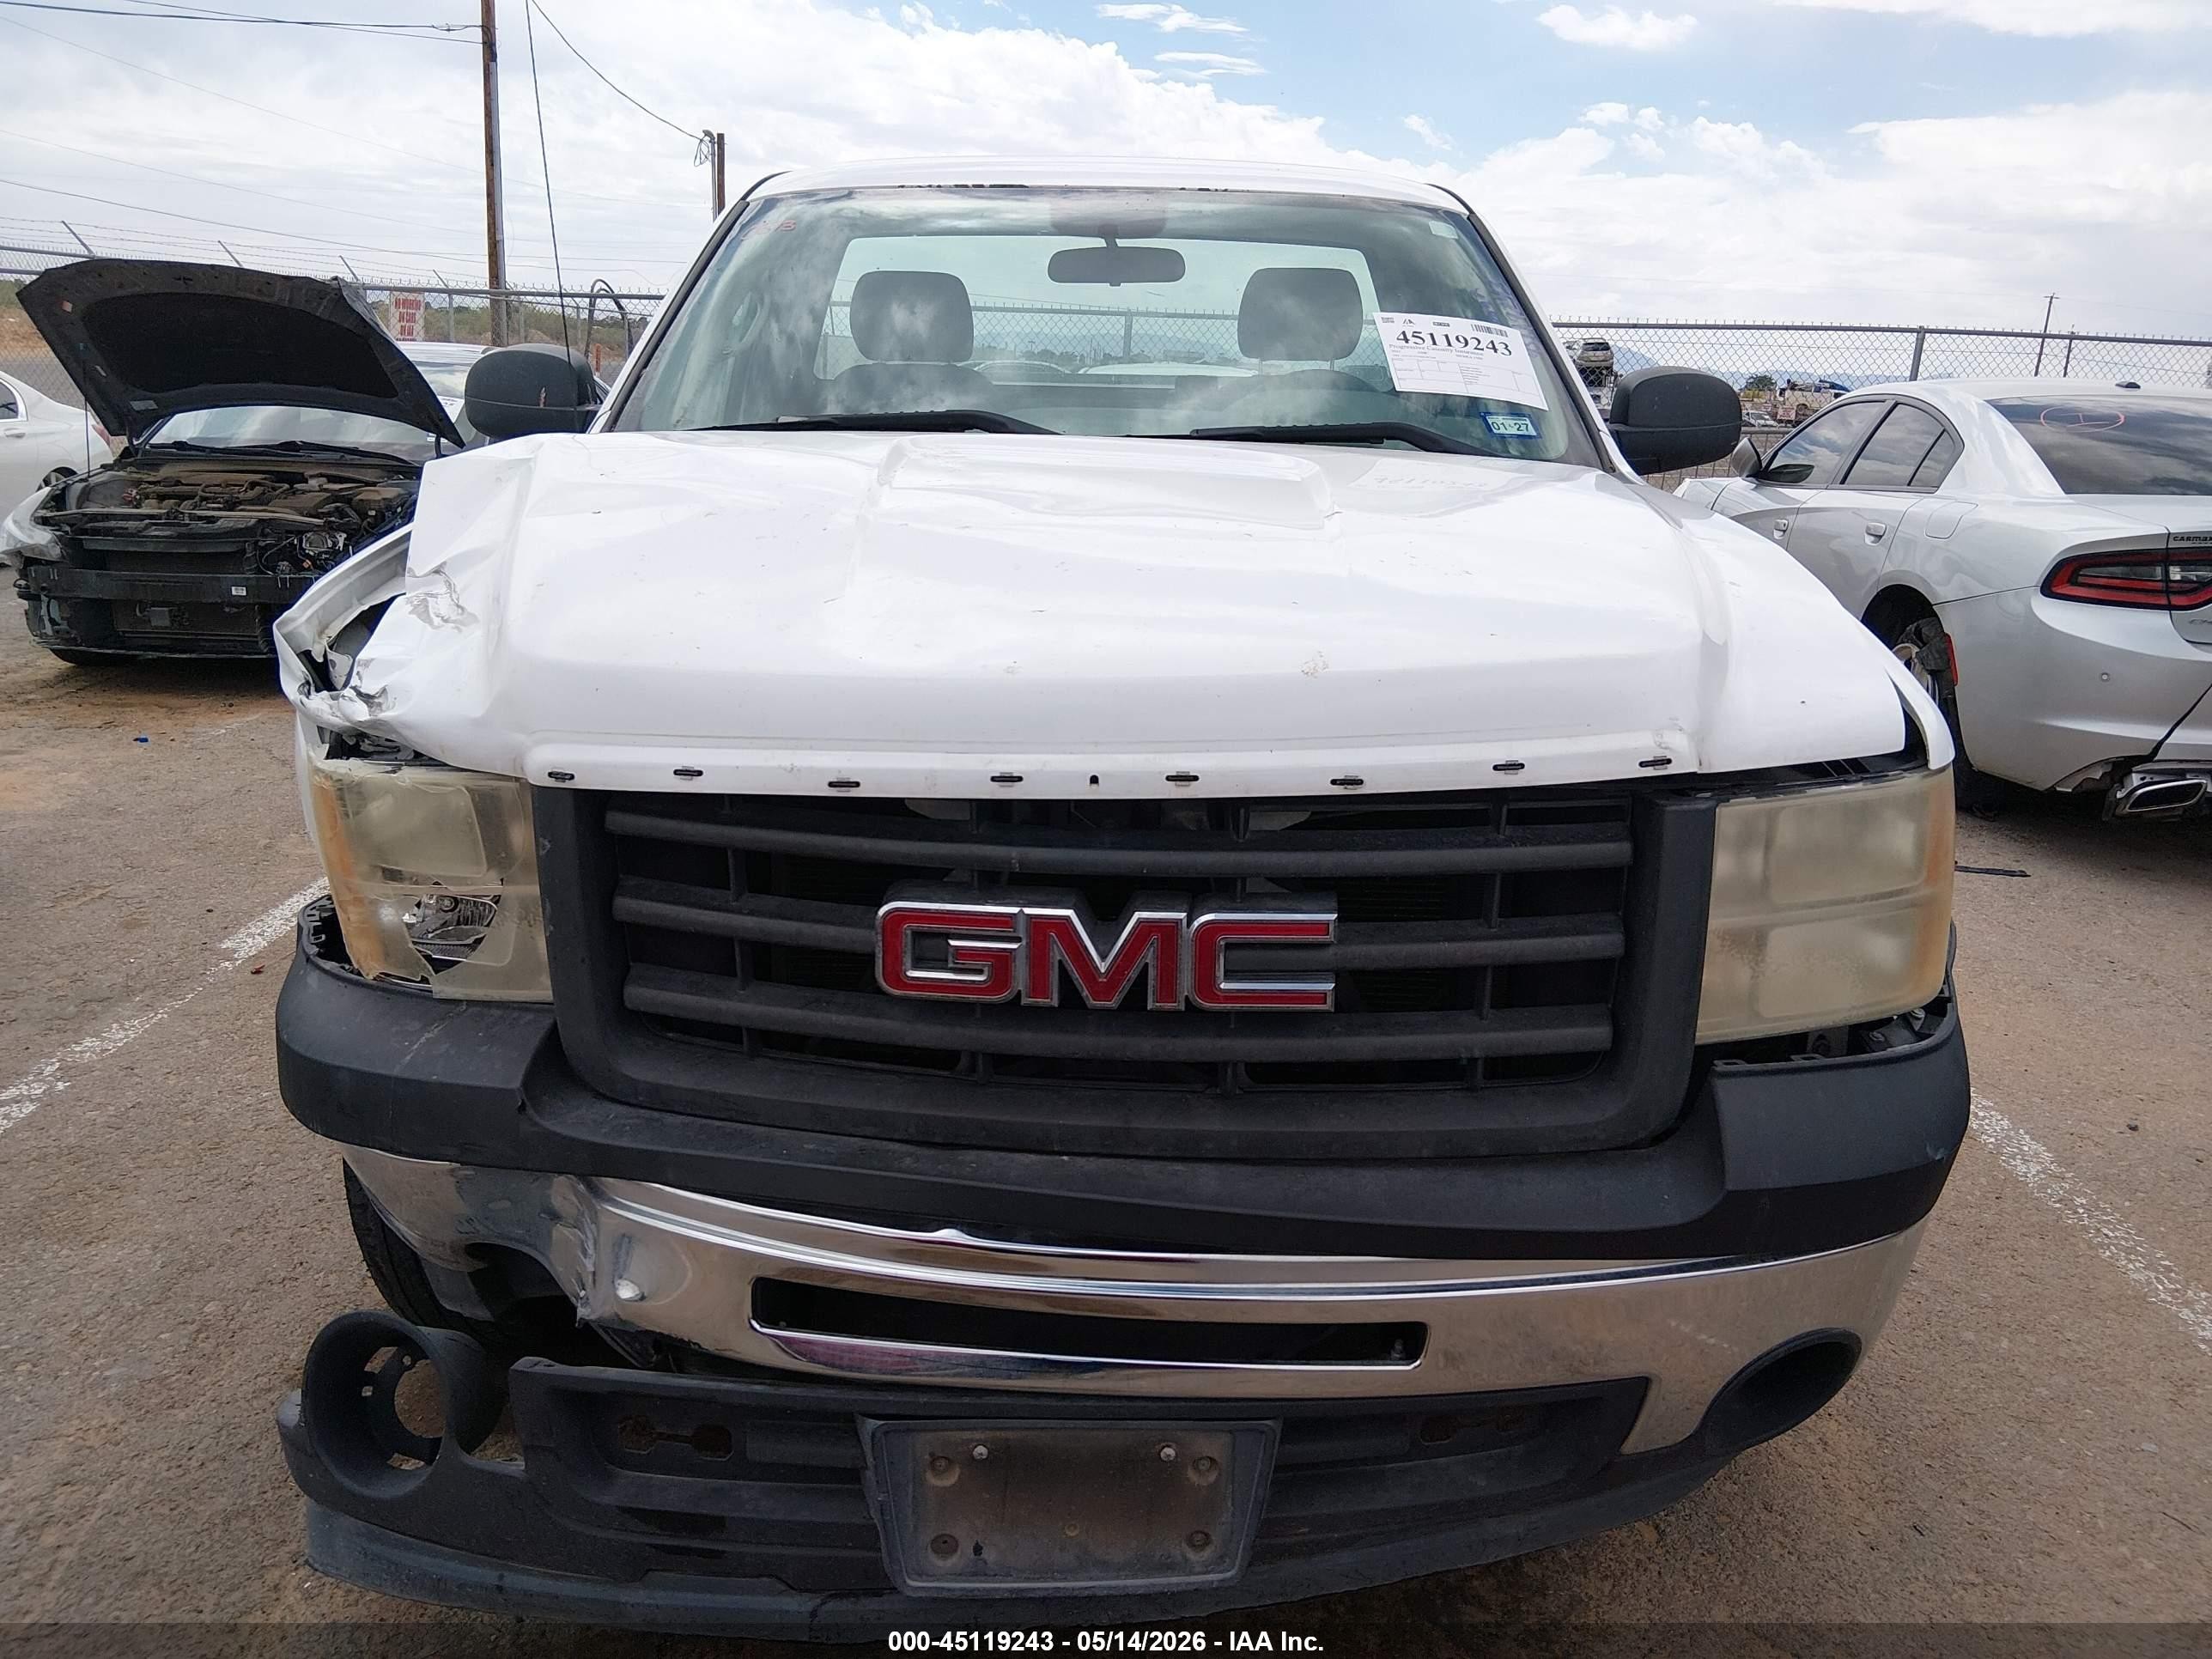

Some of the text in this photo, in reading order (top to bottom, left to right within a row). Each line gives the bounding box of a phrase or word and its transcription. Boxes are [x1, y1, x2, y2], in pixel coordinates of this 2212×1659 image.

[1396, 330, 1512, 356] 45119243
[1492, 422, 1528, 432] 01 27
[876, 900, 1339, 1013] GMC
